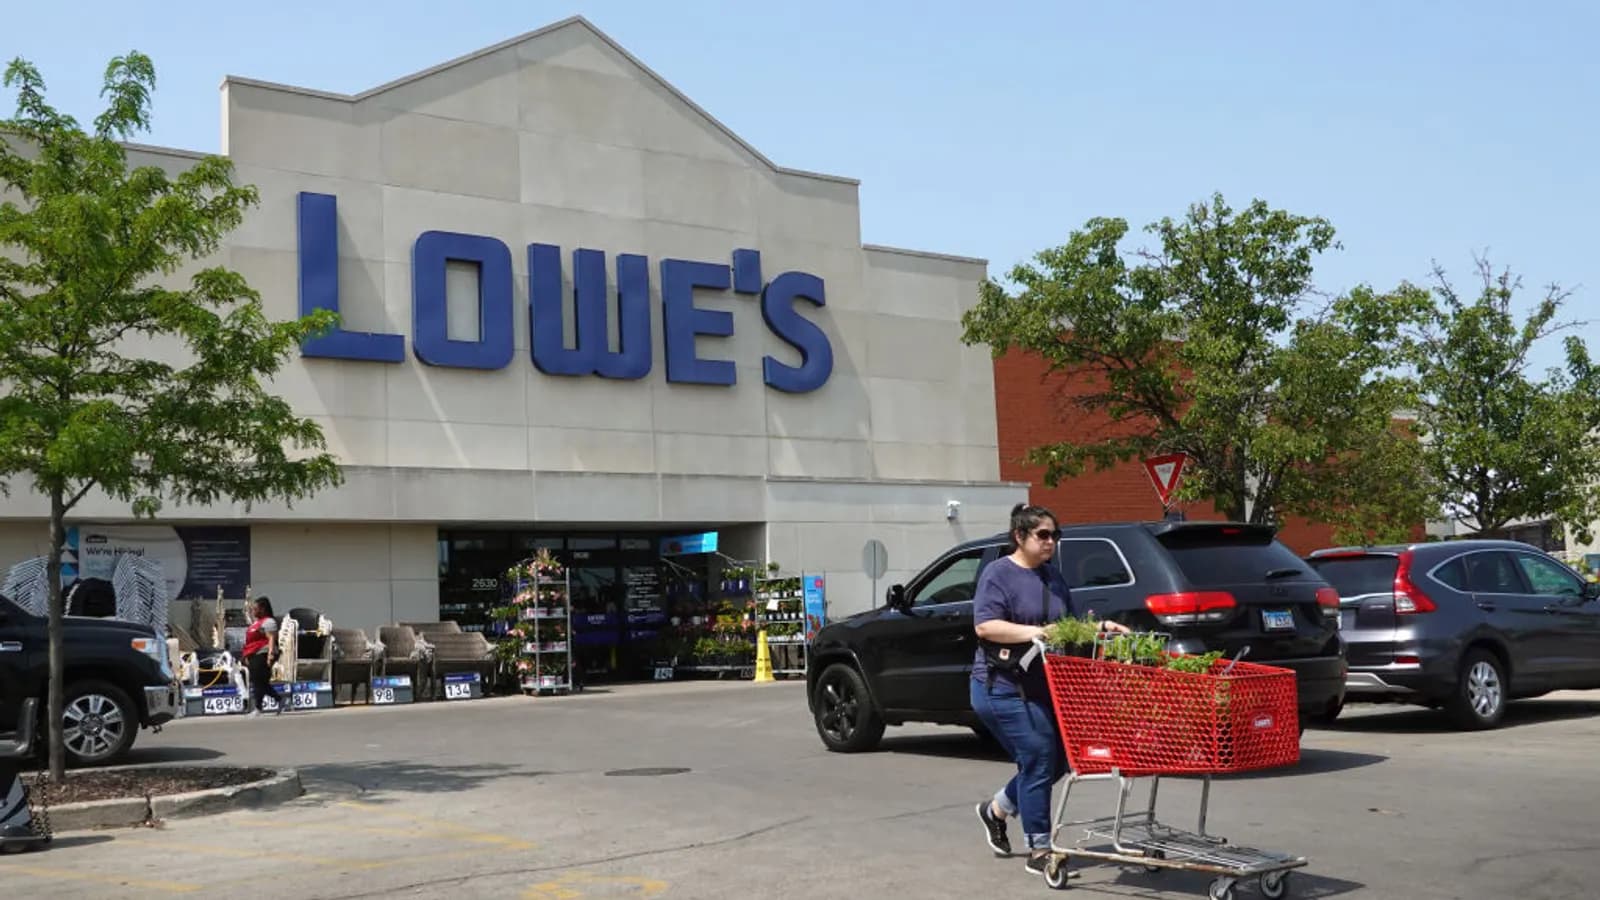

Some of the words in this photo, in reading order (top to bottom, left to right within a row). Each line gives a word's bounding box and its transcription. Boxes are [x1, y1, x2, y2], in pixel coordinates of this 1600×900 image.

[296, 191, 834, 394] LOWE'S
[86, 547, 112, 556] We're
[114, 546, 145, 557] Hiring!
[471, 578, 498, 588] 2630
[375, 689, 394, 701] 98
[447, 683, 470, 697] 134
[206, 696, 243, 711] 4898
[293, 694, 313, 706] 86
